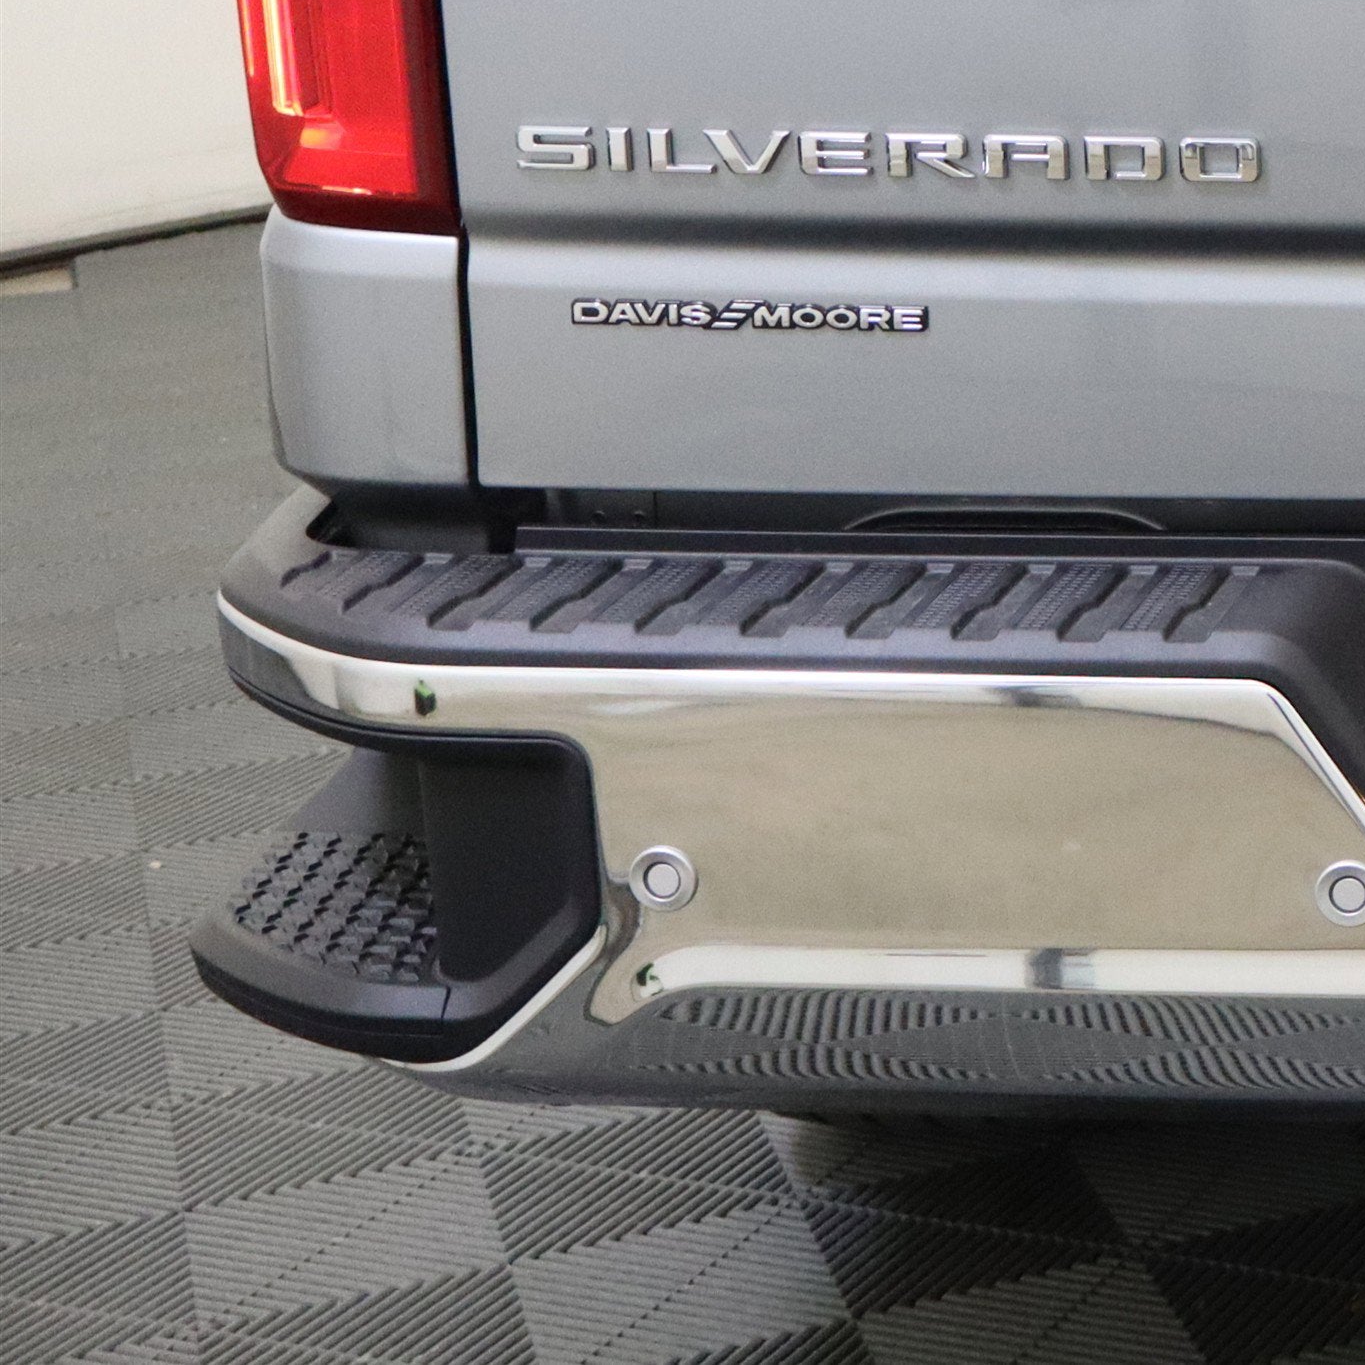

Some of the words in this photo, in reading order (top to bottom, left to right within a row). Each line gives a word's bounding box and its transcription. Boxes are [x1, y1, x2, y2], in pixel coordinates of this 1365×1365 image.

[516, 125, 1263, 183] SILVERADO
[571, 298, 715, 326] DAVIS
[752, 301, 930, 333] MOORE
